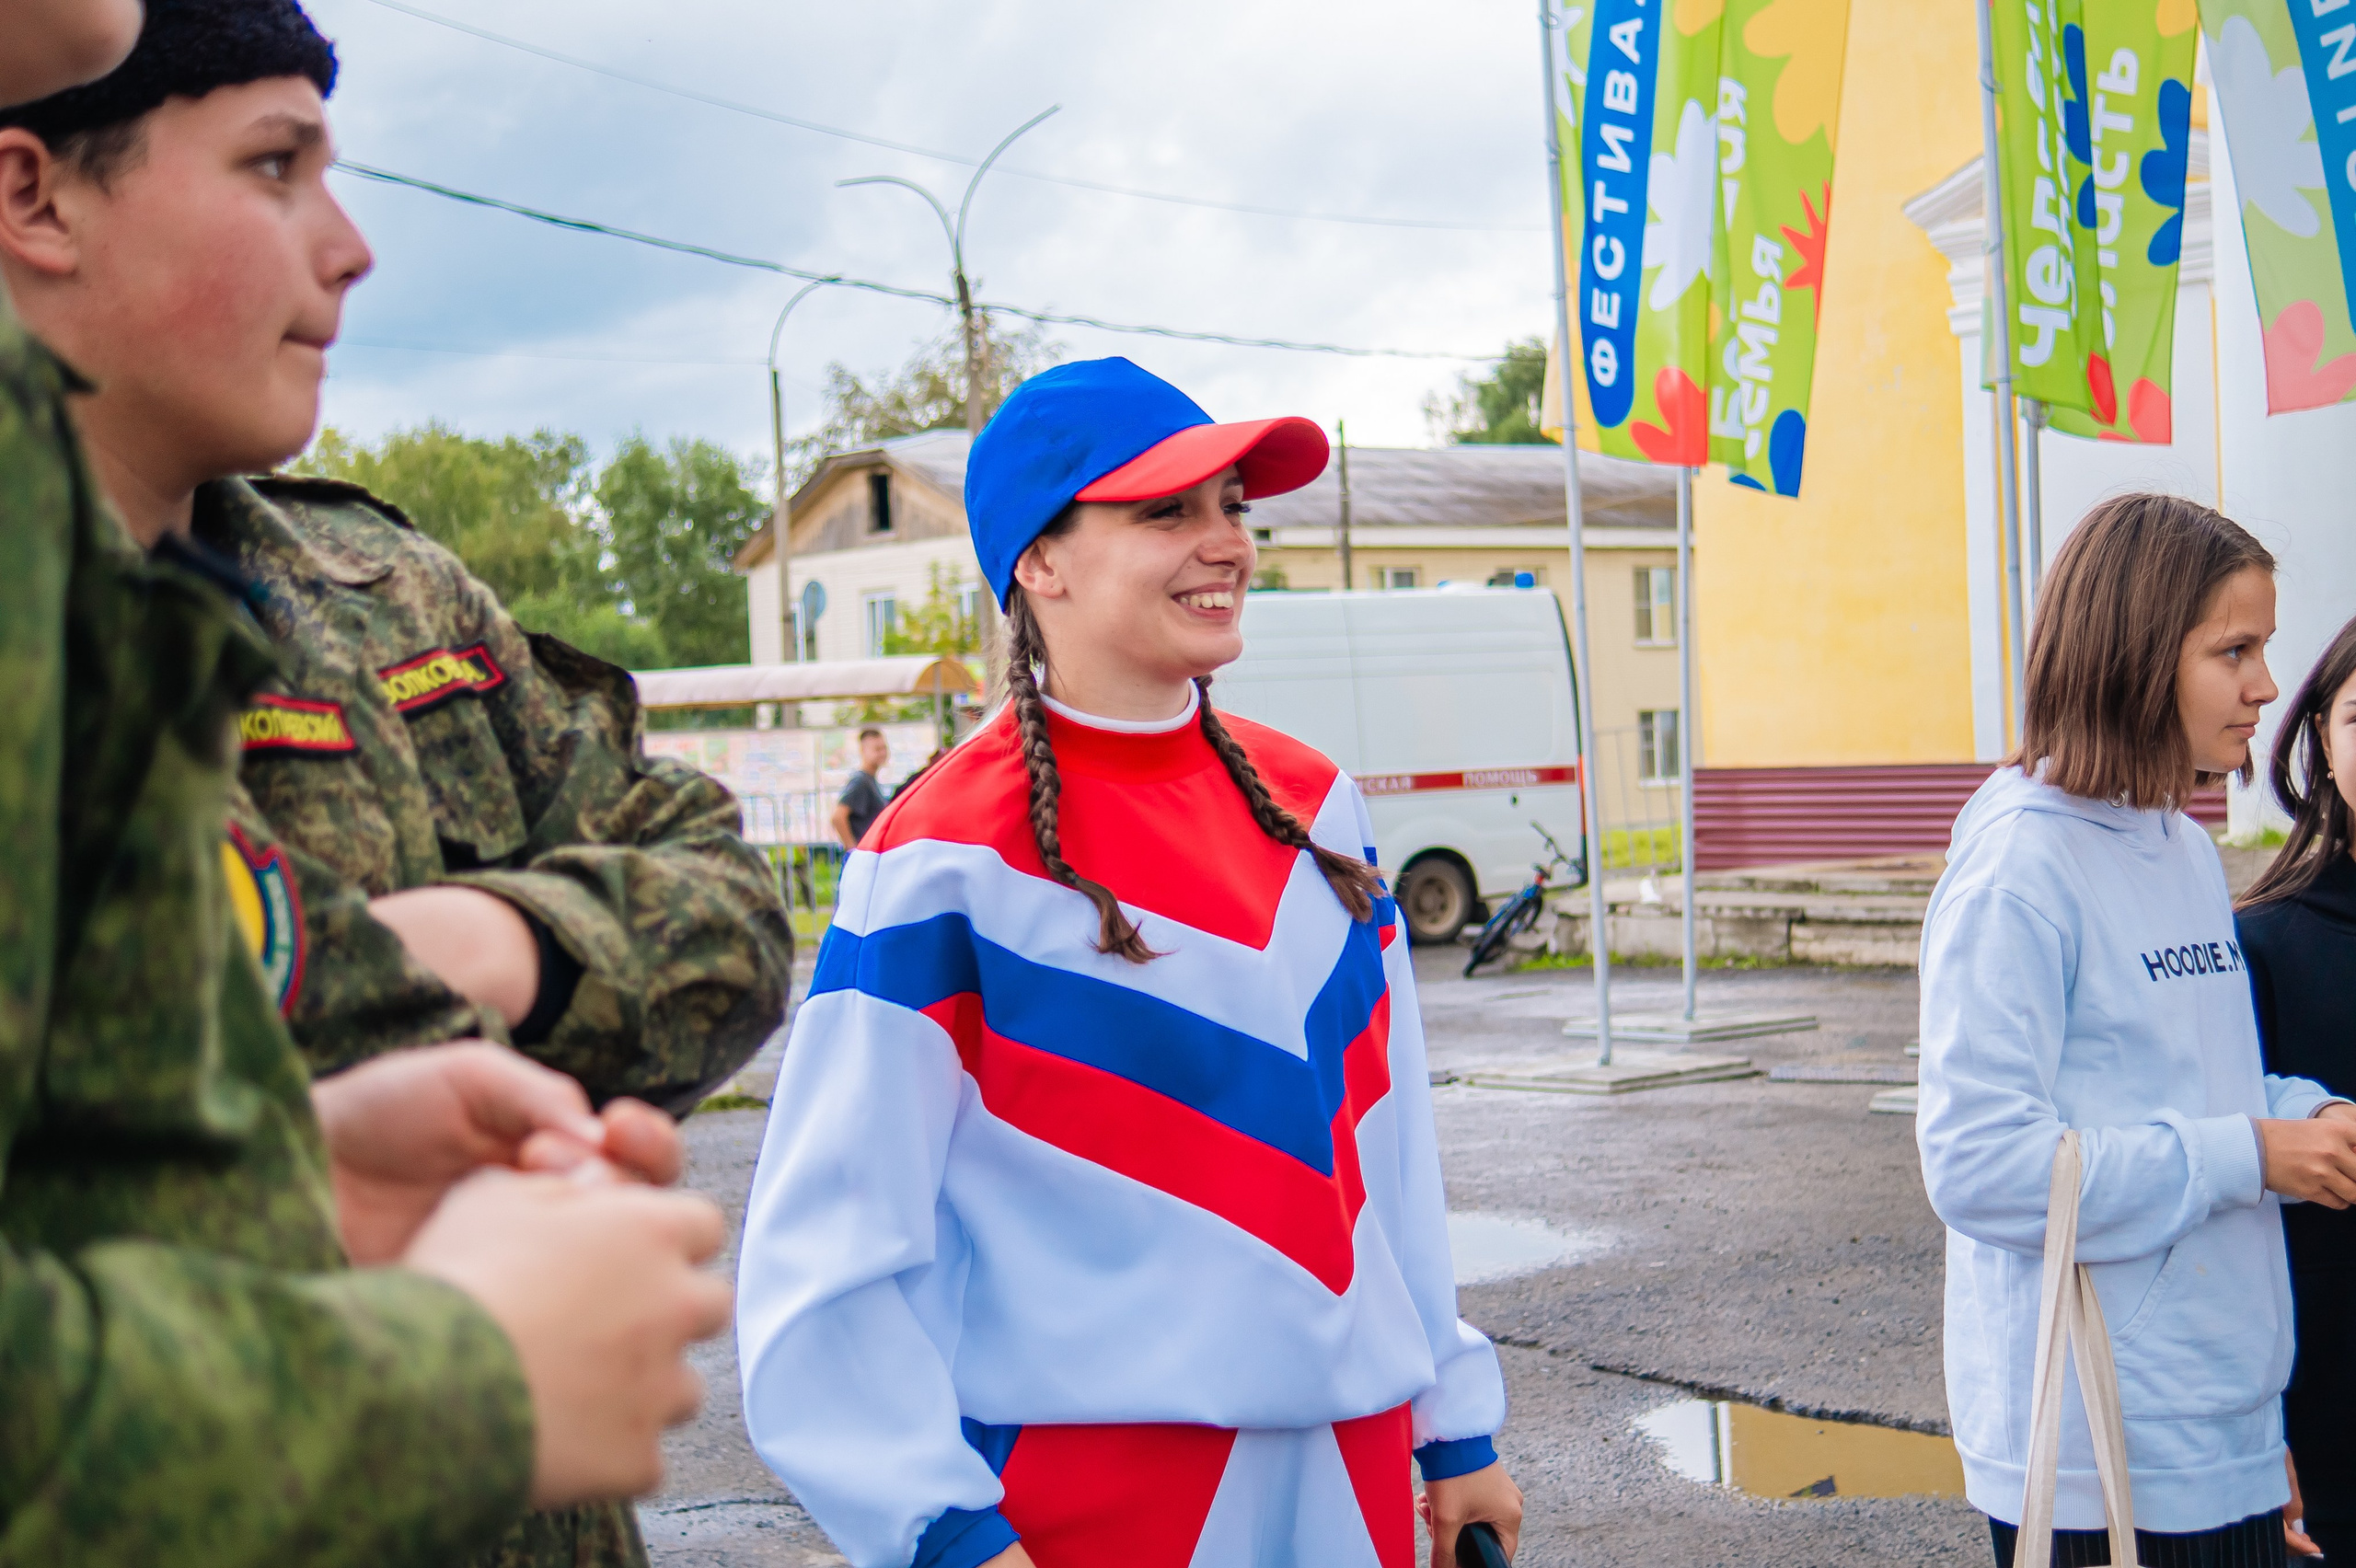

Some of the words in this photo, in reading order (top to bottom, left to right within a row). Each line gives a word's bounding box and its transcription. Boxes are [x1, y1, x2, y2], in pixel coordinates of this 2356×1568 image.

[1590, 0, 1646, 387] ФЕСТИВА
[2092, 48, 2140, 349] асть
[1464, 768, 1538, 787] ПОМОЩЬ
